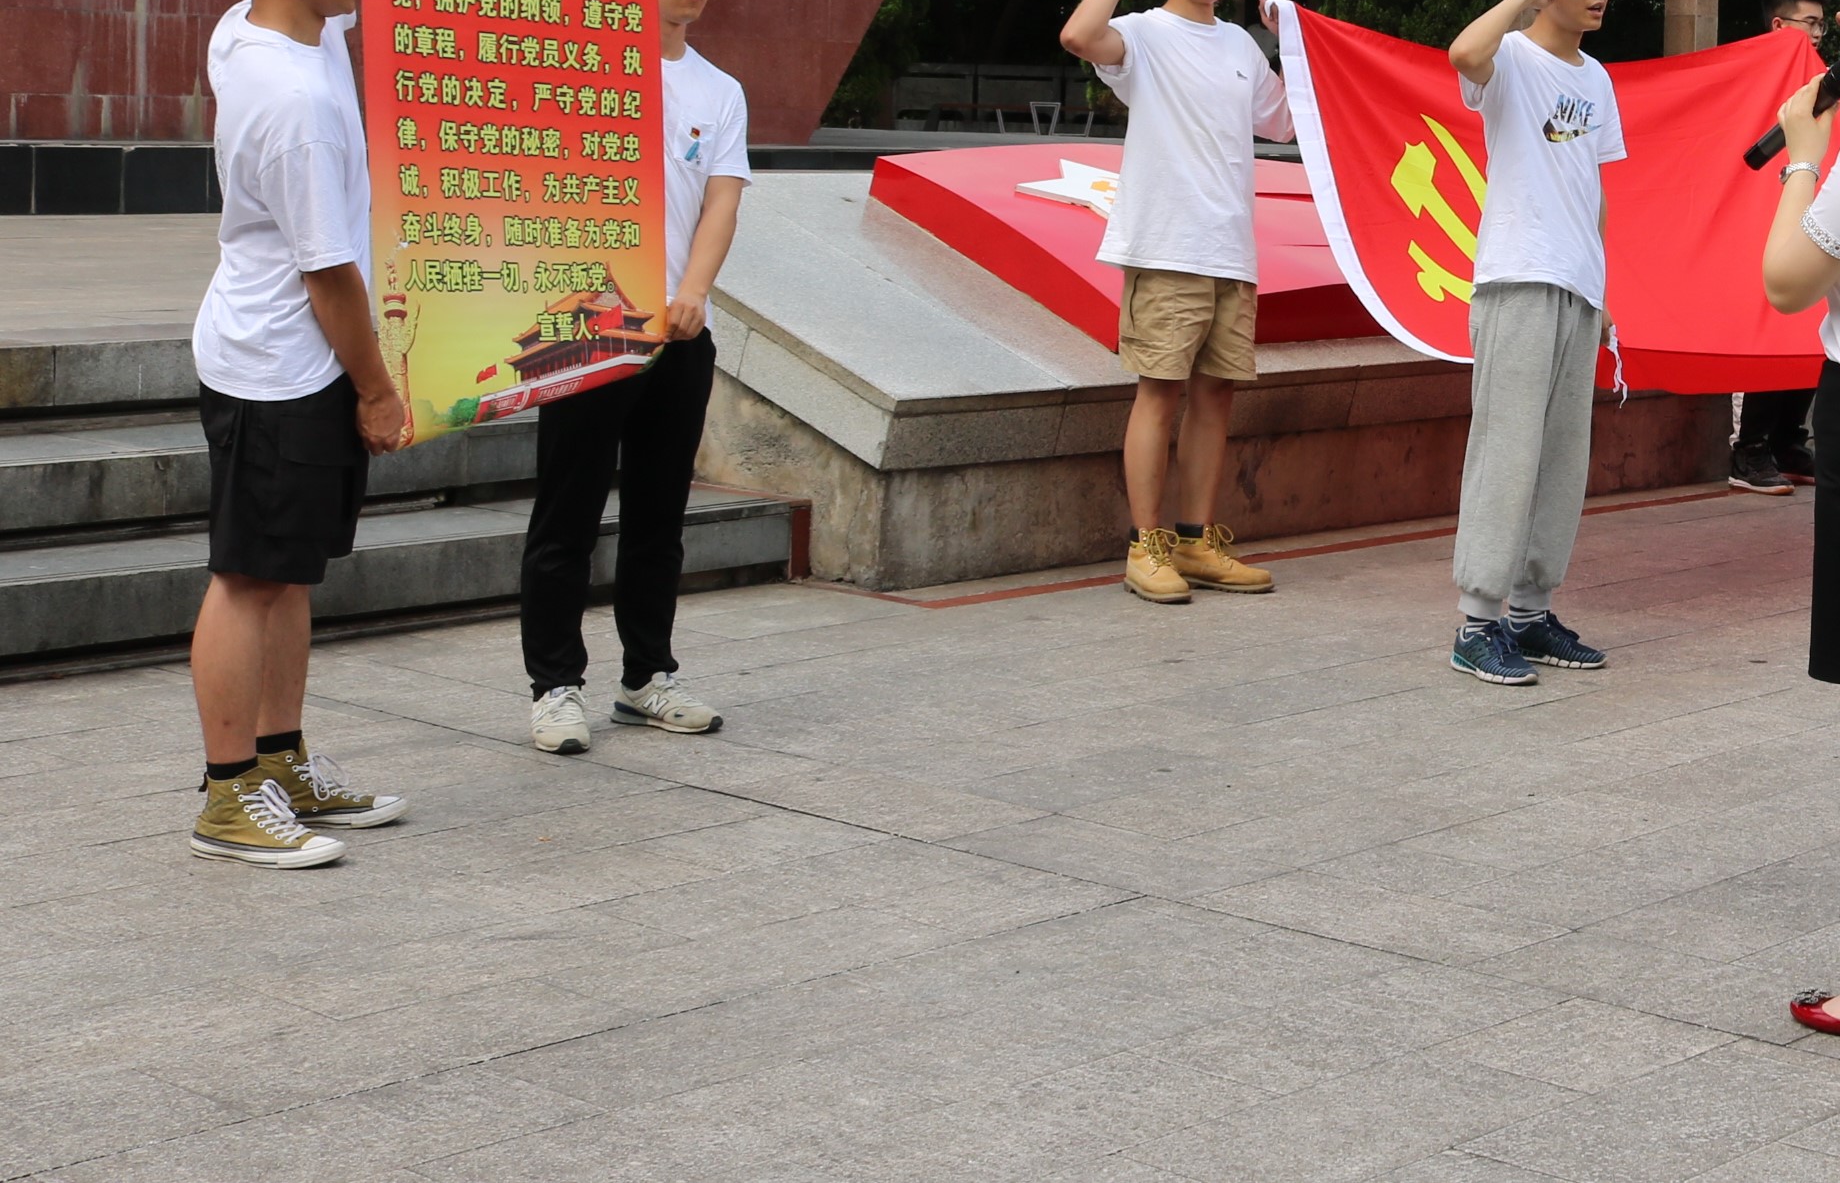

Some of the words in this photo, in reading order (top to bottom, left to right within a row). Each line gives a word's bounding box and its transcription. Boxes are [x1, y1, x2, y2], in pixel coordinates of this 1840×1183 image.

[393, 23, 643, 76] 的章程，履行党员义务，执
[395, 69, 642, 119] 行党的决定，严守党的纪
[1553, 95, 1595, 126] NIKE
[397, 117, 641, 162] 律，保守党的秘密，对党忠
[399, 164, 641, 206] 诚，积极工作，为共产主义
[401, 211, 640, 250] 奋斗终身，随时准备为党和
